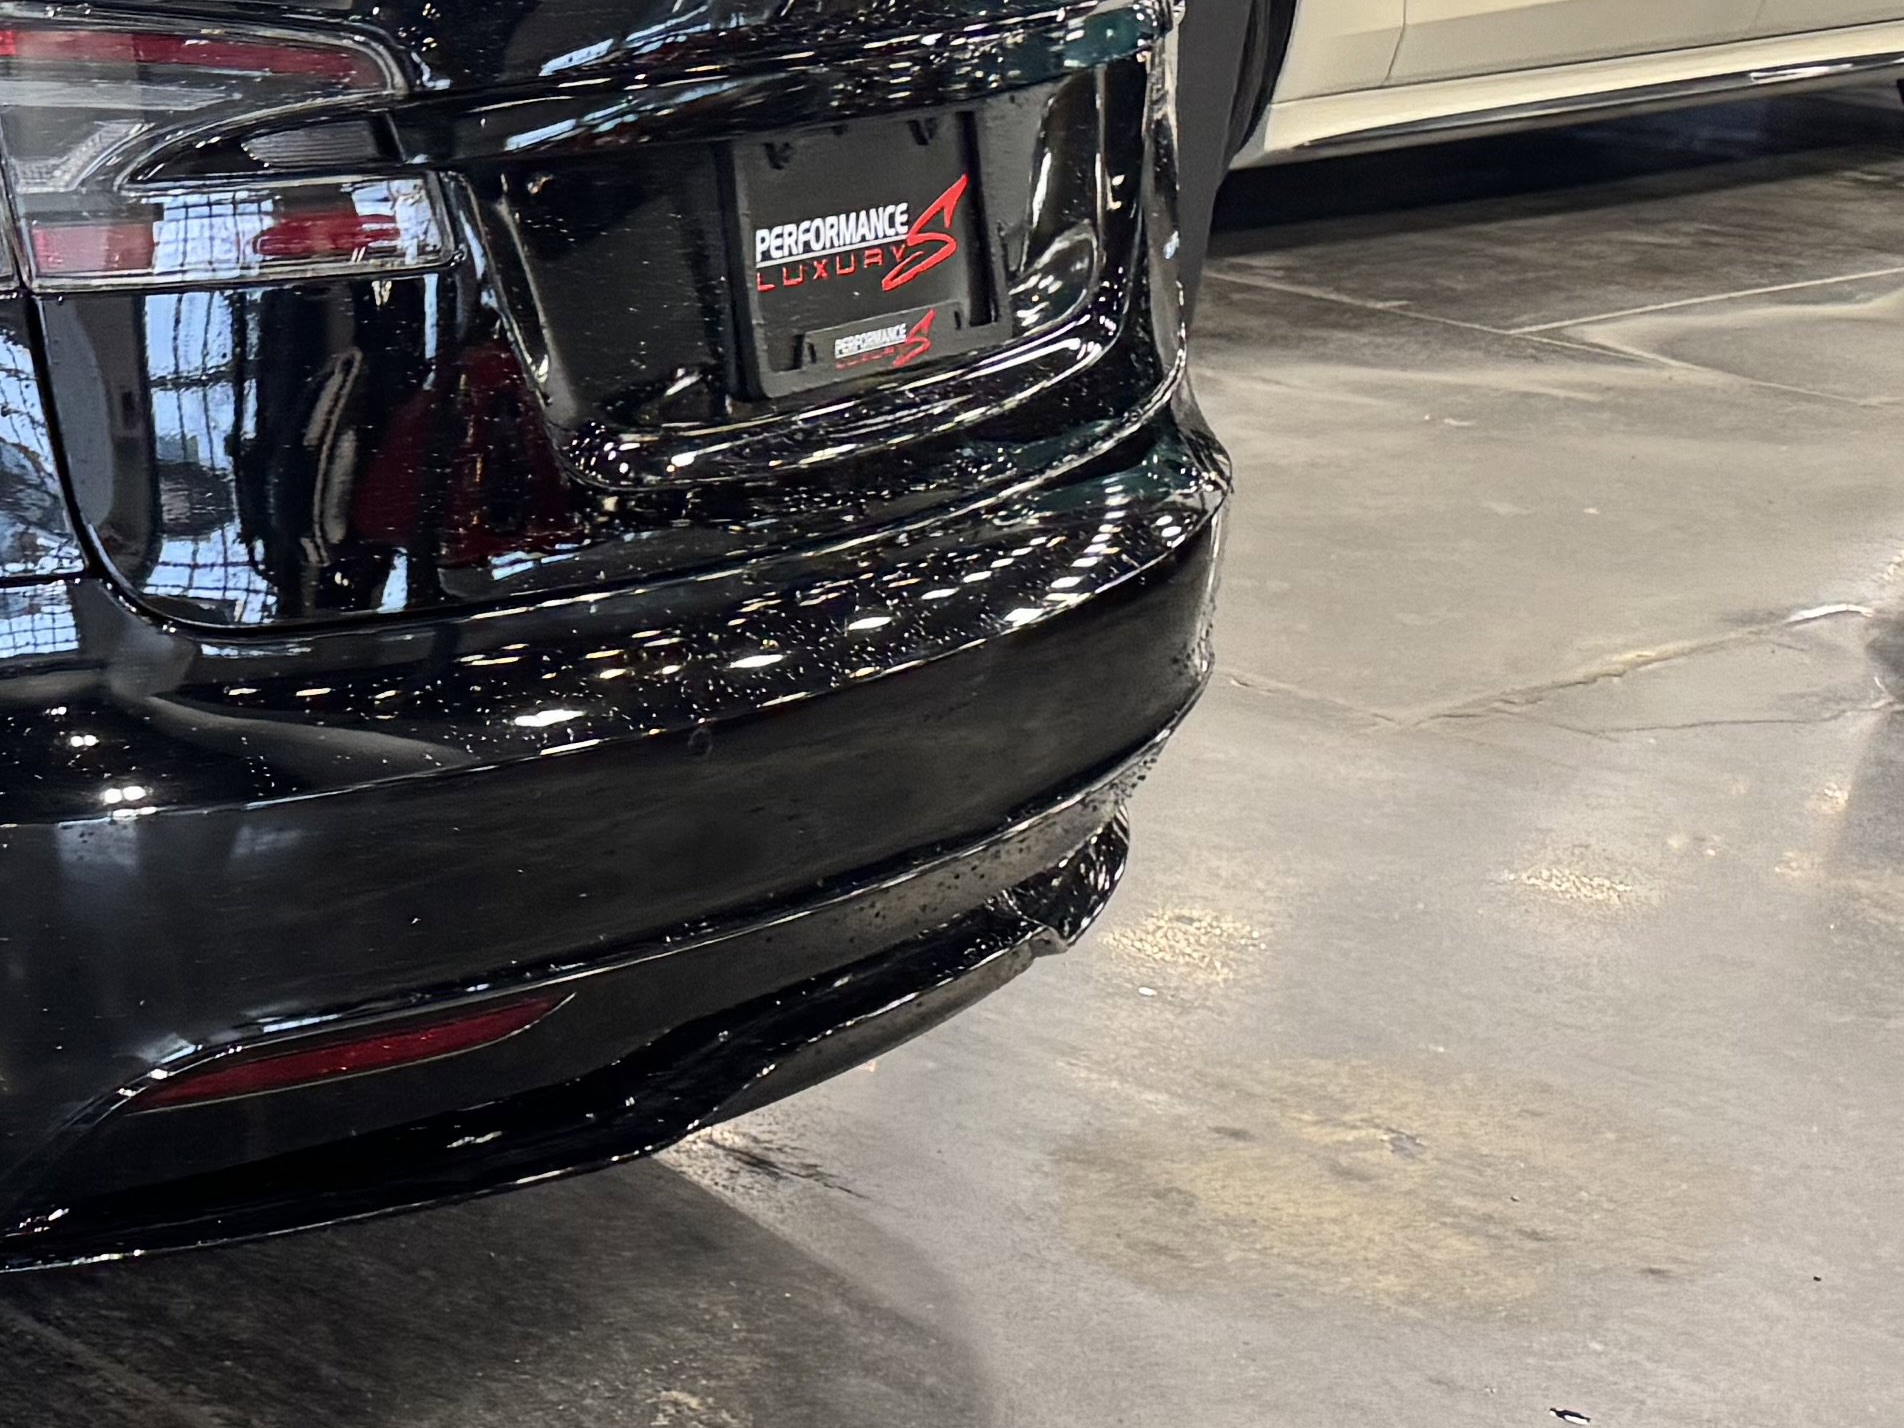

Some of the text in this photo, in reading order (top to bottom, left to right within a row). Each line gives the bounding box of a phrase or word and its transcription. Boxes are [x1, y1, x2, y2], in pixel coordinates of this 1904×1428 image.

[755, 202, 909, 263] PERFORMANCE
[756, 244, 907, 293] LUXURY
[835, 323, 906, 357] PERFORMANCE
